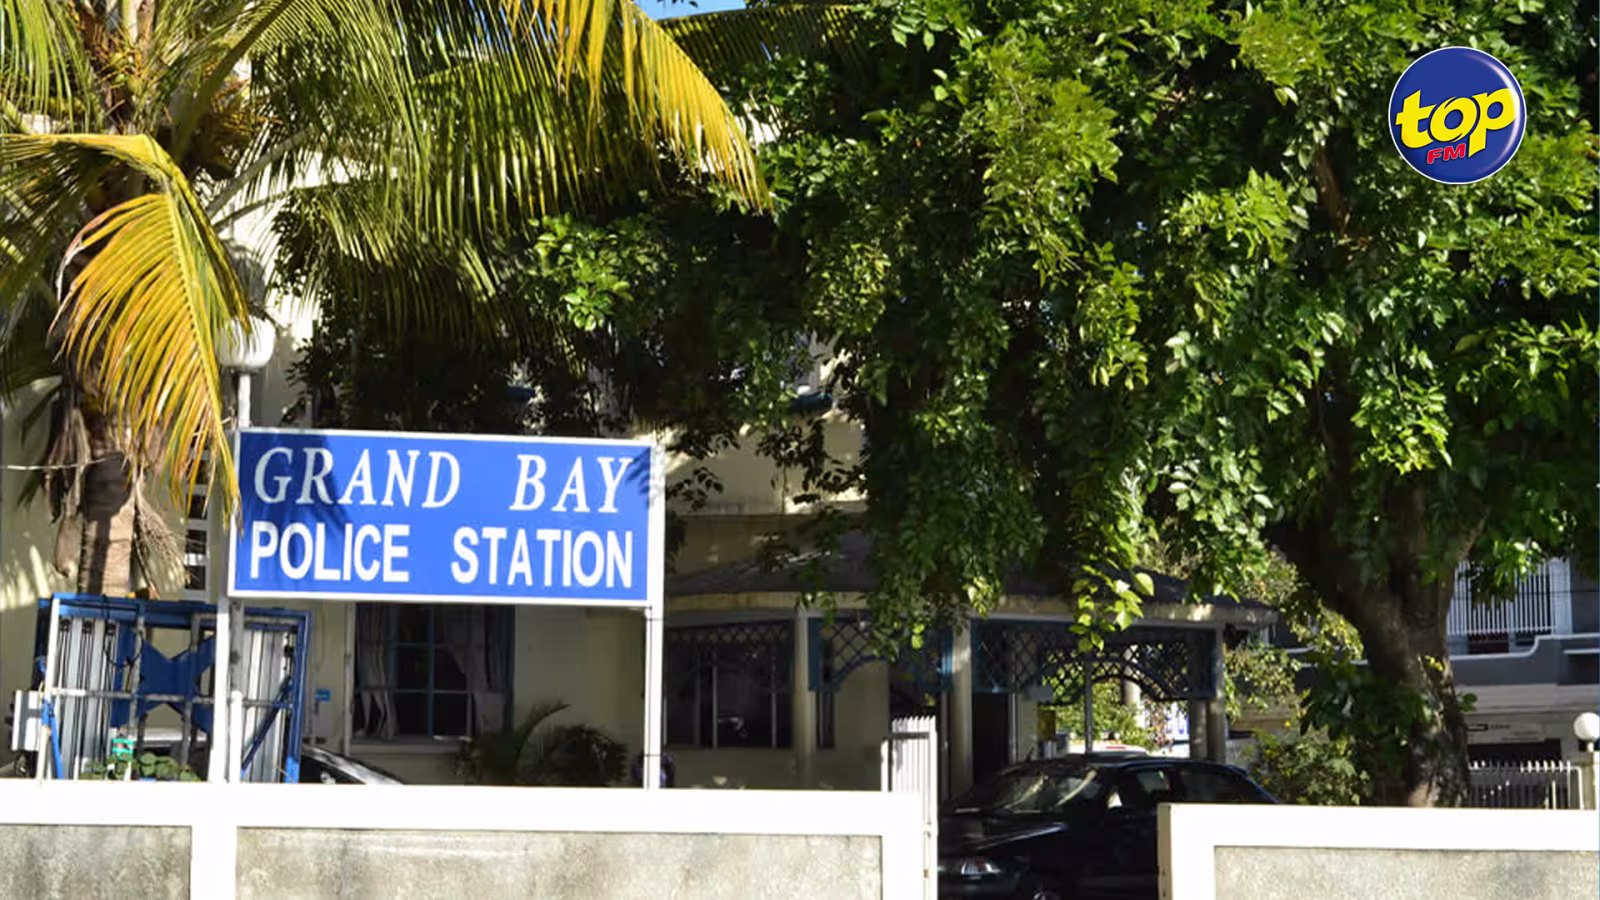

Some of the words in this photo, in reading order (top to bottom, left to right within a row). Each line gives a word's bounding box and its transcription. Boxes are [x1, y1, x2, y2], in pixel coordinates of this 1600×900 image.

[254, 446, 461, 508] GRAND
[509, 454, 633, 513] BAY
[250, 521, 410, 582] POLICE
[450, 526, 633, 588] STATION
